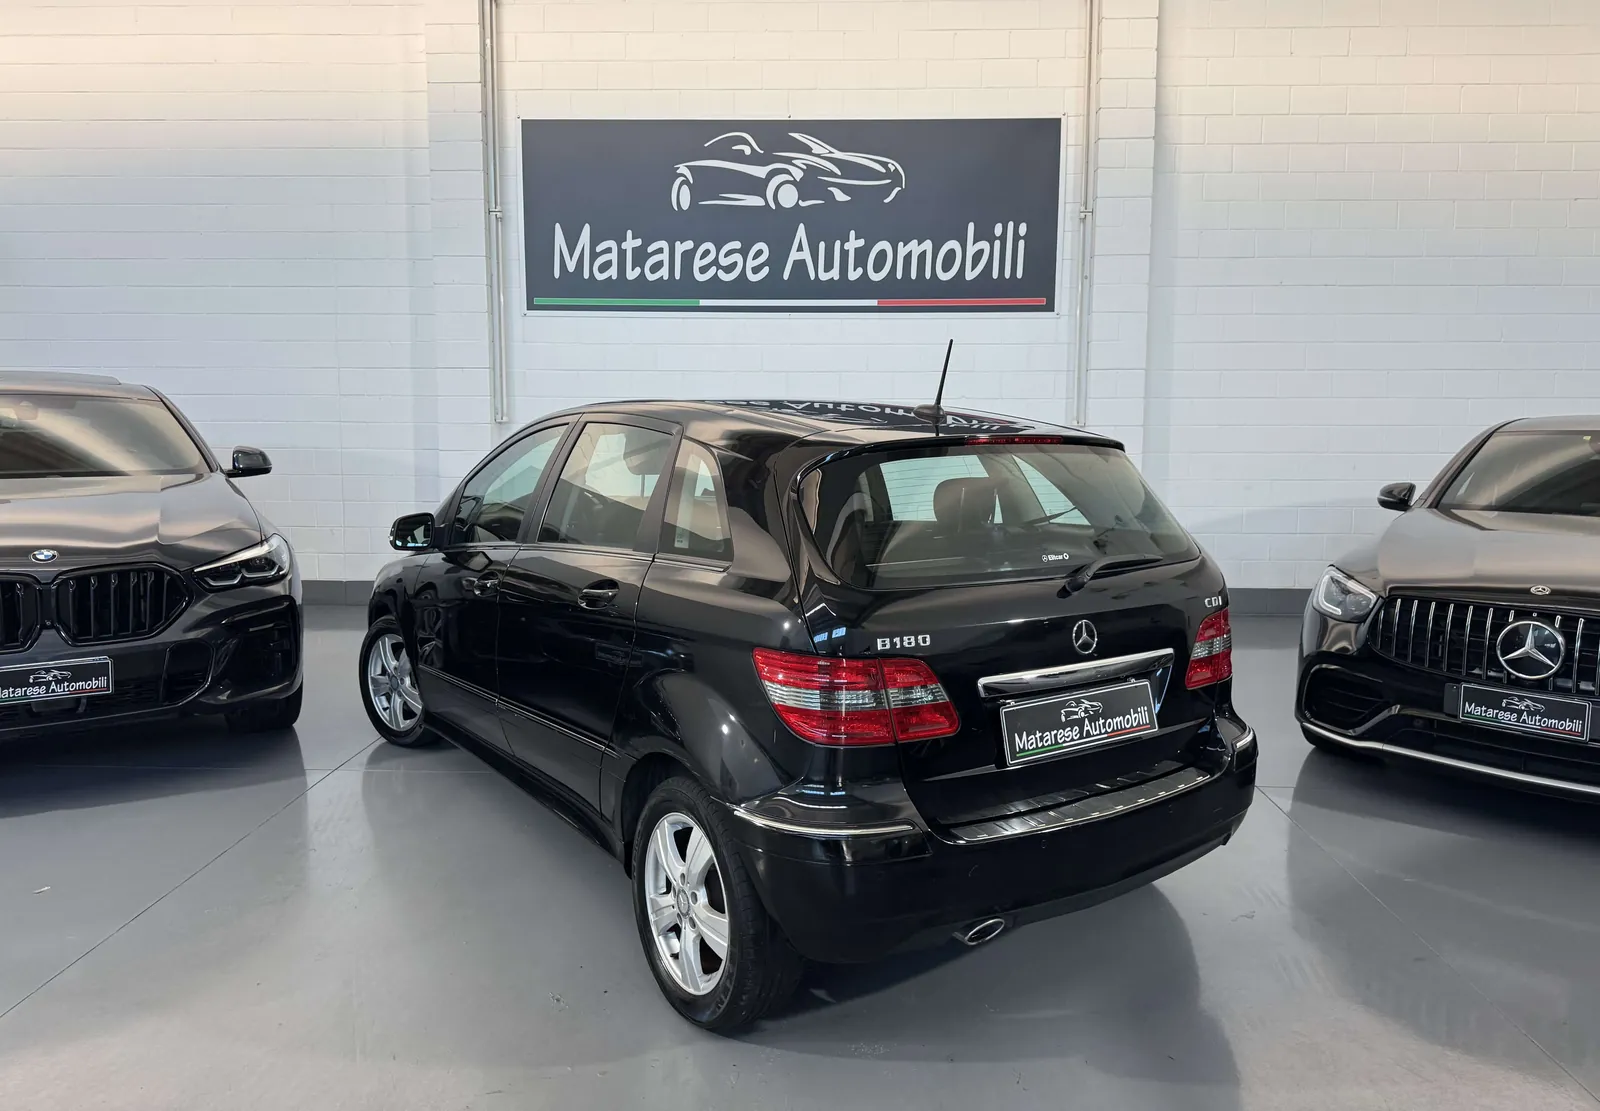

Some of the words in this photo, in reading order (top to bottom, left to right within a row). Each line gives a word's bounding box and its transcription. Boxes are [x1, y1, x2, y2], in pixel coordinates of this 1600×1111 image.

[553, 222, 770, 282] Matarese
[782, 221, 1027, 282] Automobili
[1204, 595, 1222, 608] CDI
[0, 685, 47, 699] atarese
[49, 676, 107, 693] Automobili
[1014, 725, 1081, 752] Matarese
[1083, 705, 1150, 738] Automobili
[1464, 701, 1518, 722] Matarese
[1519, 710, 1583, 733] Automobili
